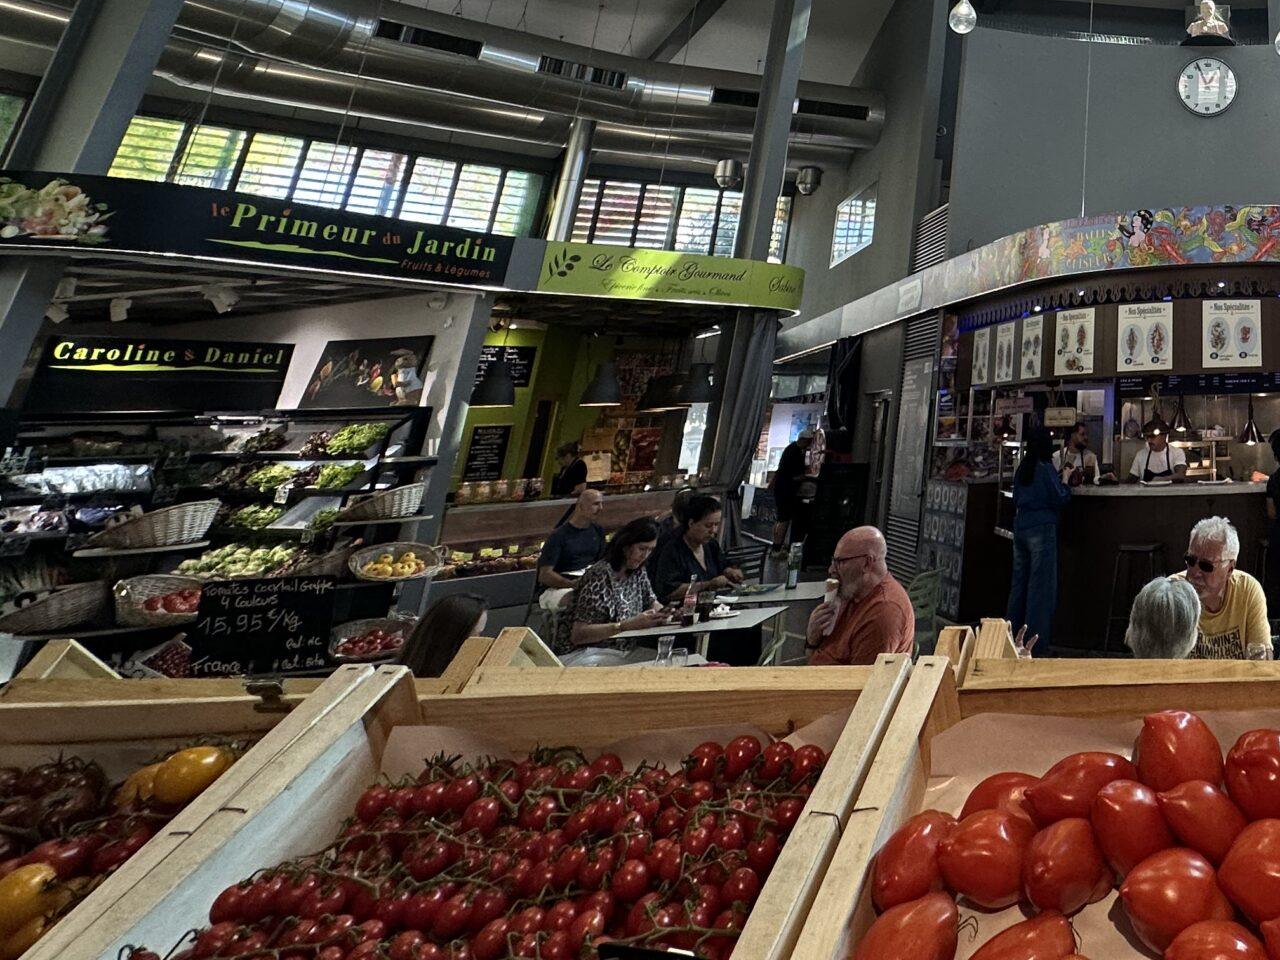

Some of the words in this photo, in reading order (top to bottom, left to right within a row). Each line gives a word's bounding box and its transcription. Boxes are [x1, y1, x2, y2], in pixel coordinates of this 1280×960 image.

[229, 202, 377, 246] Primeur
[382, 232, 400, 245] du
[407, 230, 497, 263] Jardin
[400, 259, 433, 273] Fruits
[588, 253, 614, 272] Le
[619, 255, 677, 280] Comptoir
[678, 261, 748, 282] Gourmand
[53, 341, 176, 362] Caroline
[204, 347, 284, 365] Daniel
[203, 582, 249, 596] Tomates
[220, 597, 229, 610] 4
